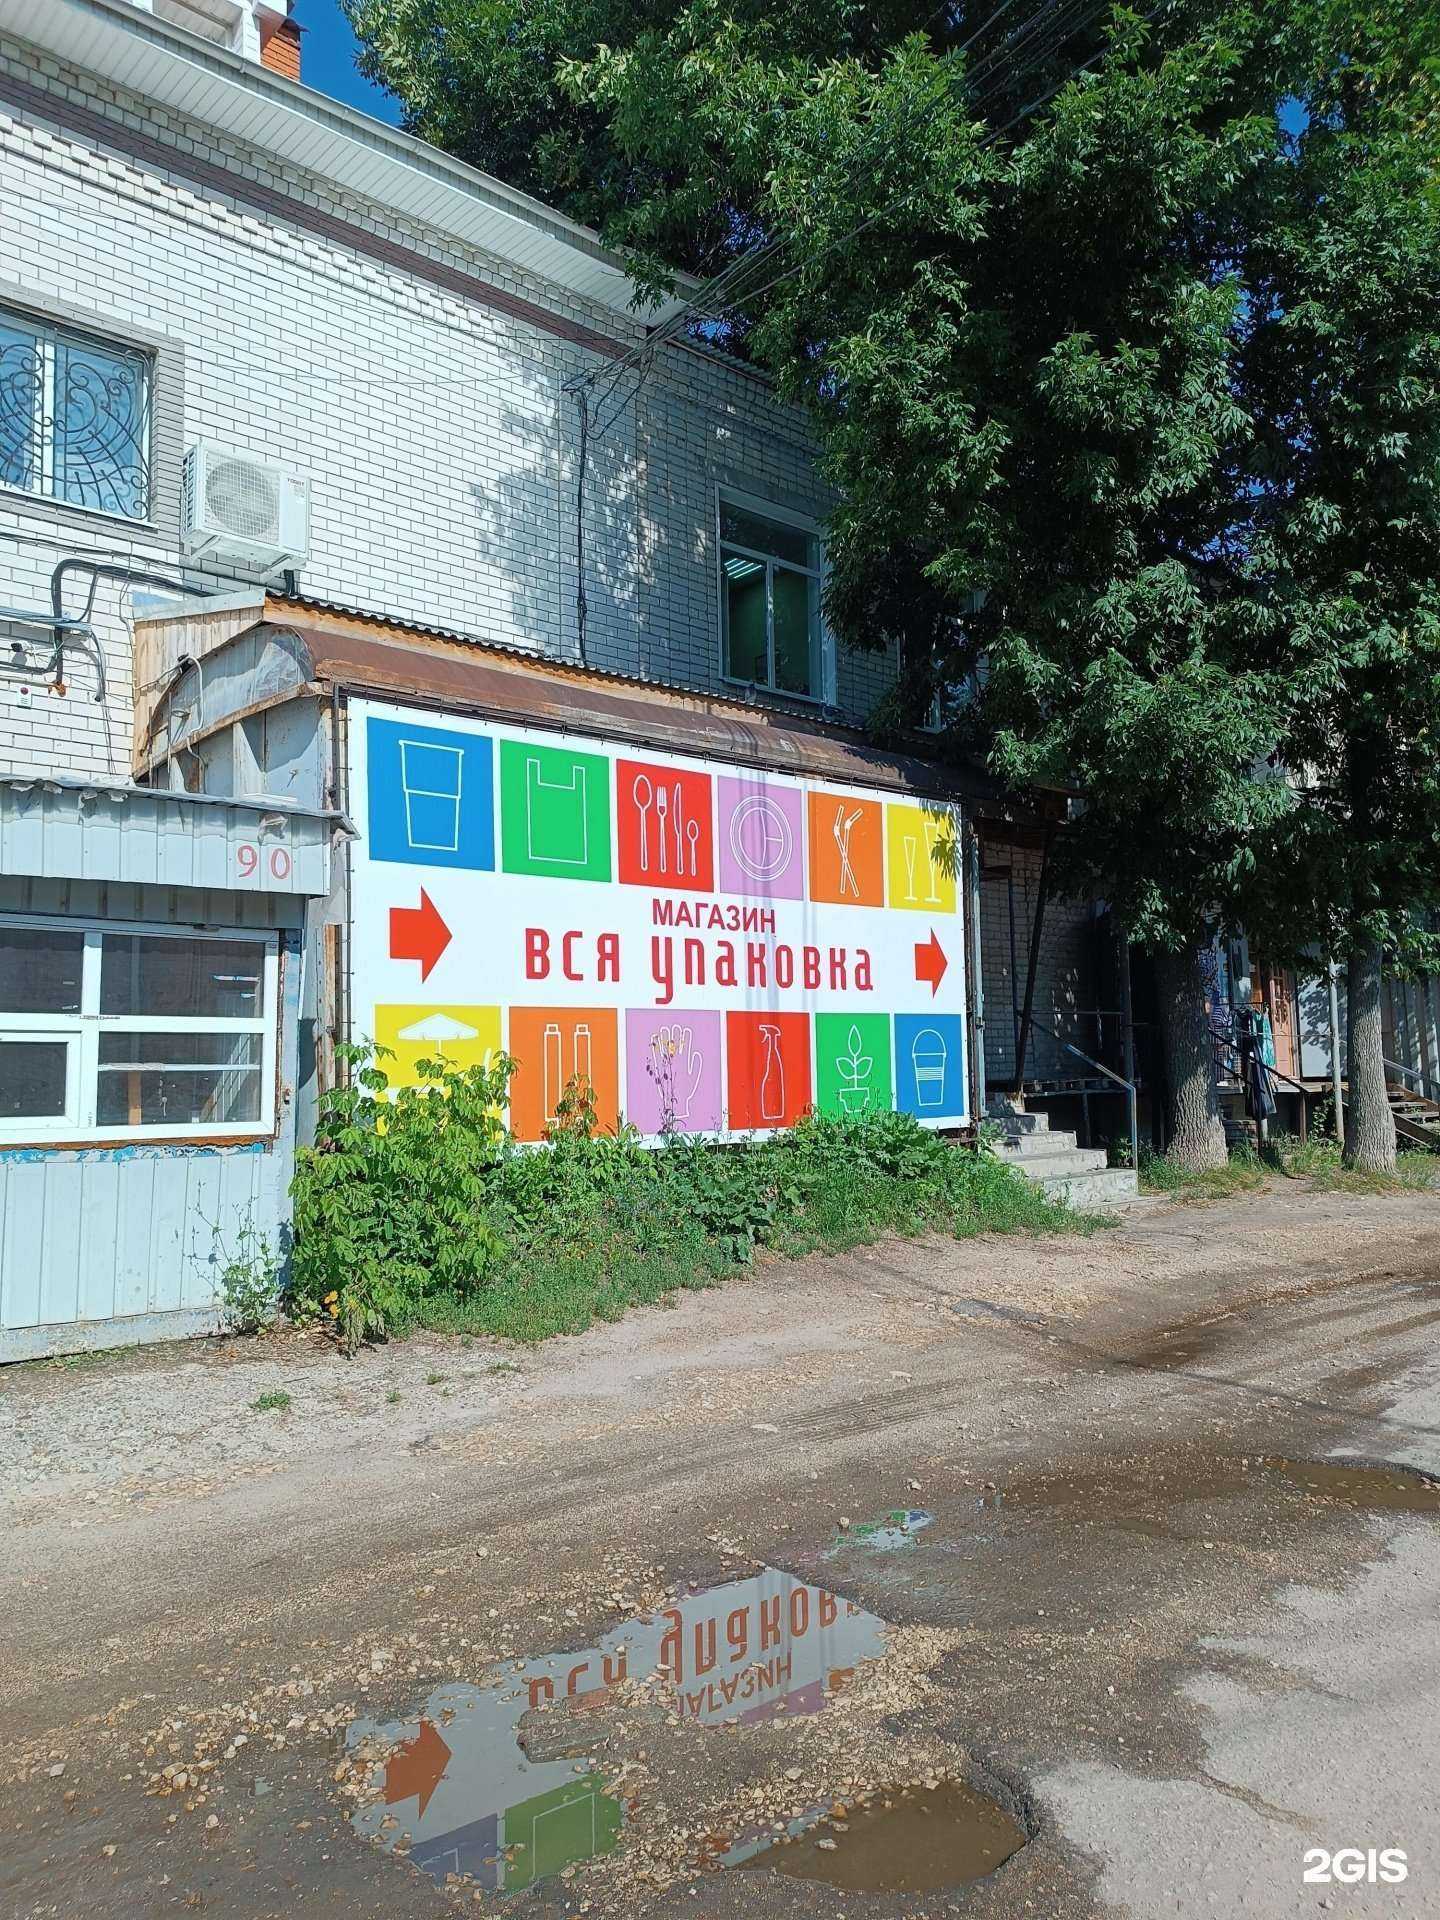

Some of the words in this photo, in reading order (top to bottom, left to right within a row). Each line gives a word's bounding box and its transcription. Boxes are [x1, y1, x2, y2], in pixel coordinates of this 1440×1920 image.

[237, 845, 291, 879] 90
[652, 898, 776, 934] МАГАЗИН
[651, 936, 874, 1005] упаковка
